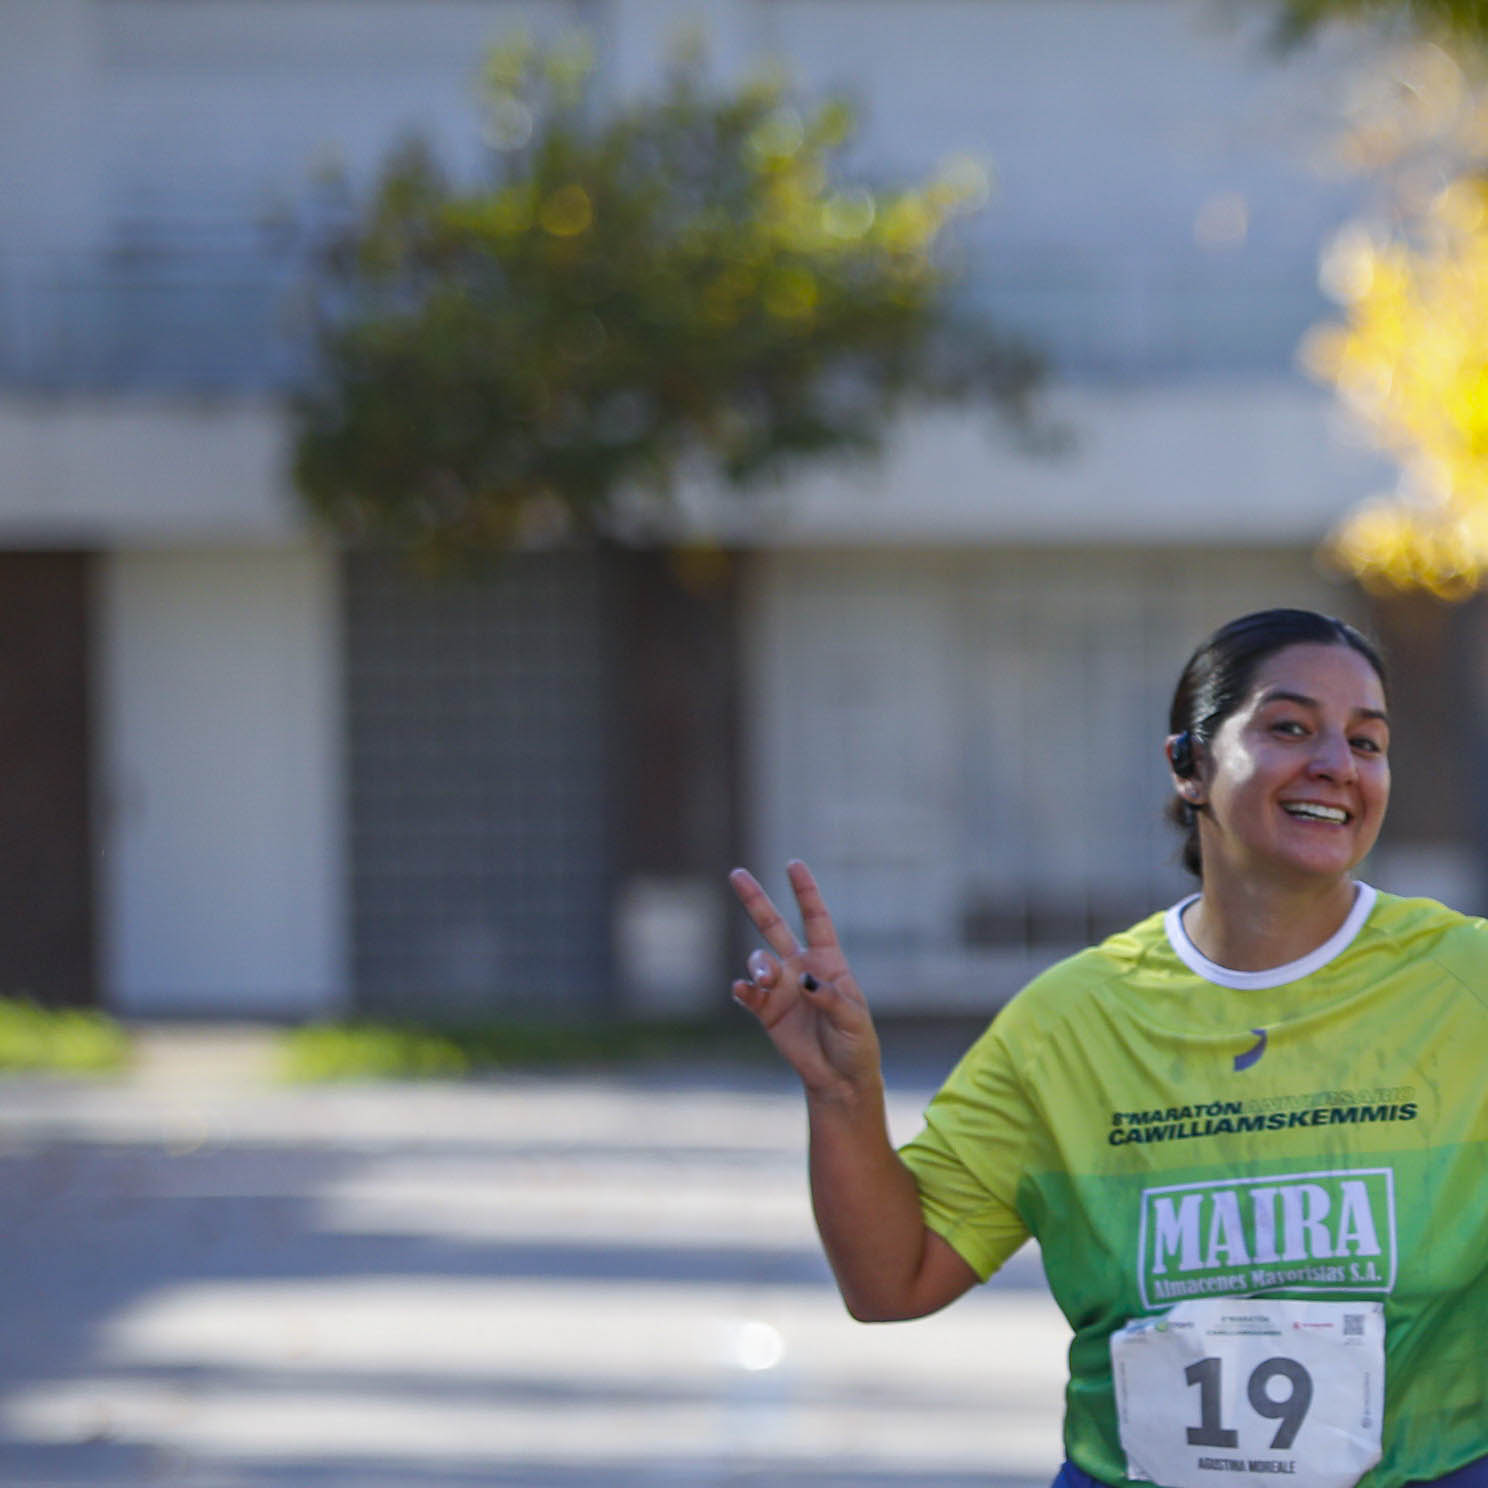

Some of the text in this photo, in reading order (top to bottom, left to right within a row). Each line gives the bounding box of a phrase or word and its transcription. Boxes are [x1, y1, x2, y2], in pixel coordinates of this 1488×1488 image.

[1108, 1103, 1418, 1146] CAWILLIAMSKEMMIS
[1152, 1181, 1382, 1274] MAIRA
[1153, 1261, 1382, 1299] Almacenes Mayoristas S.A.
[1184, 1356, 1313, 1450] 19
